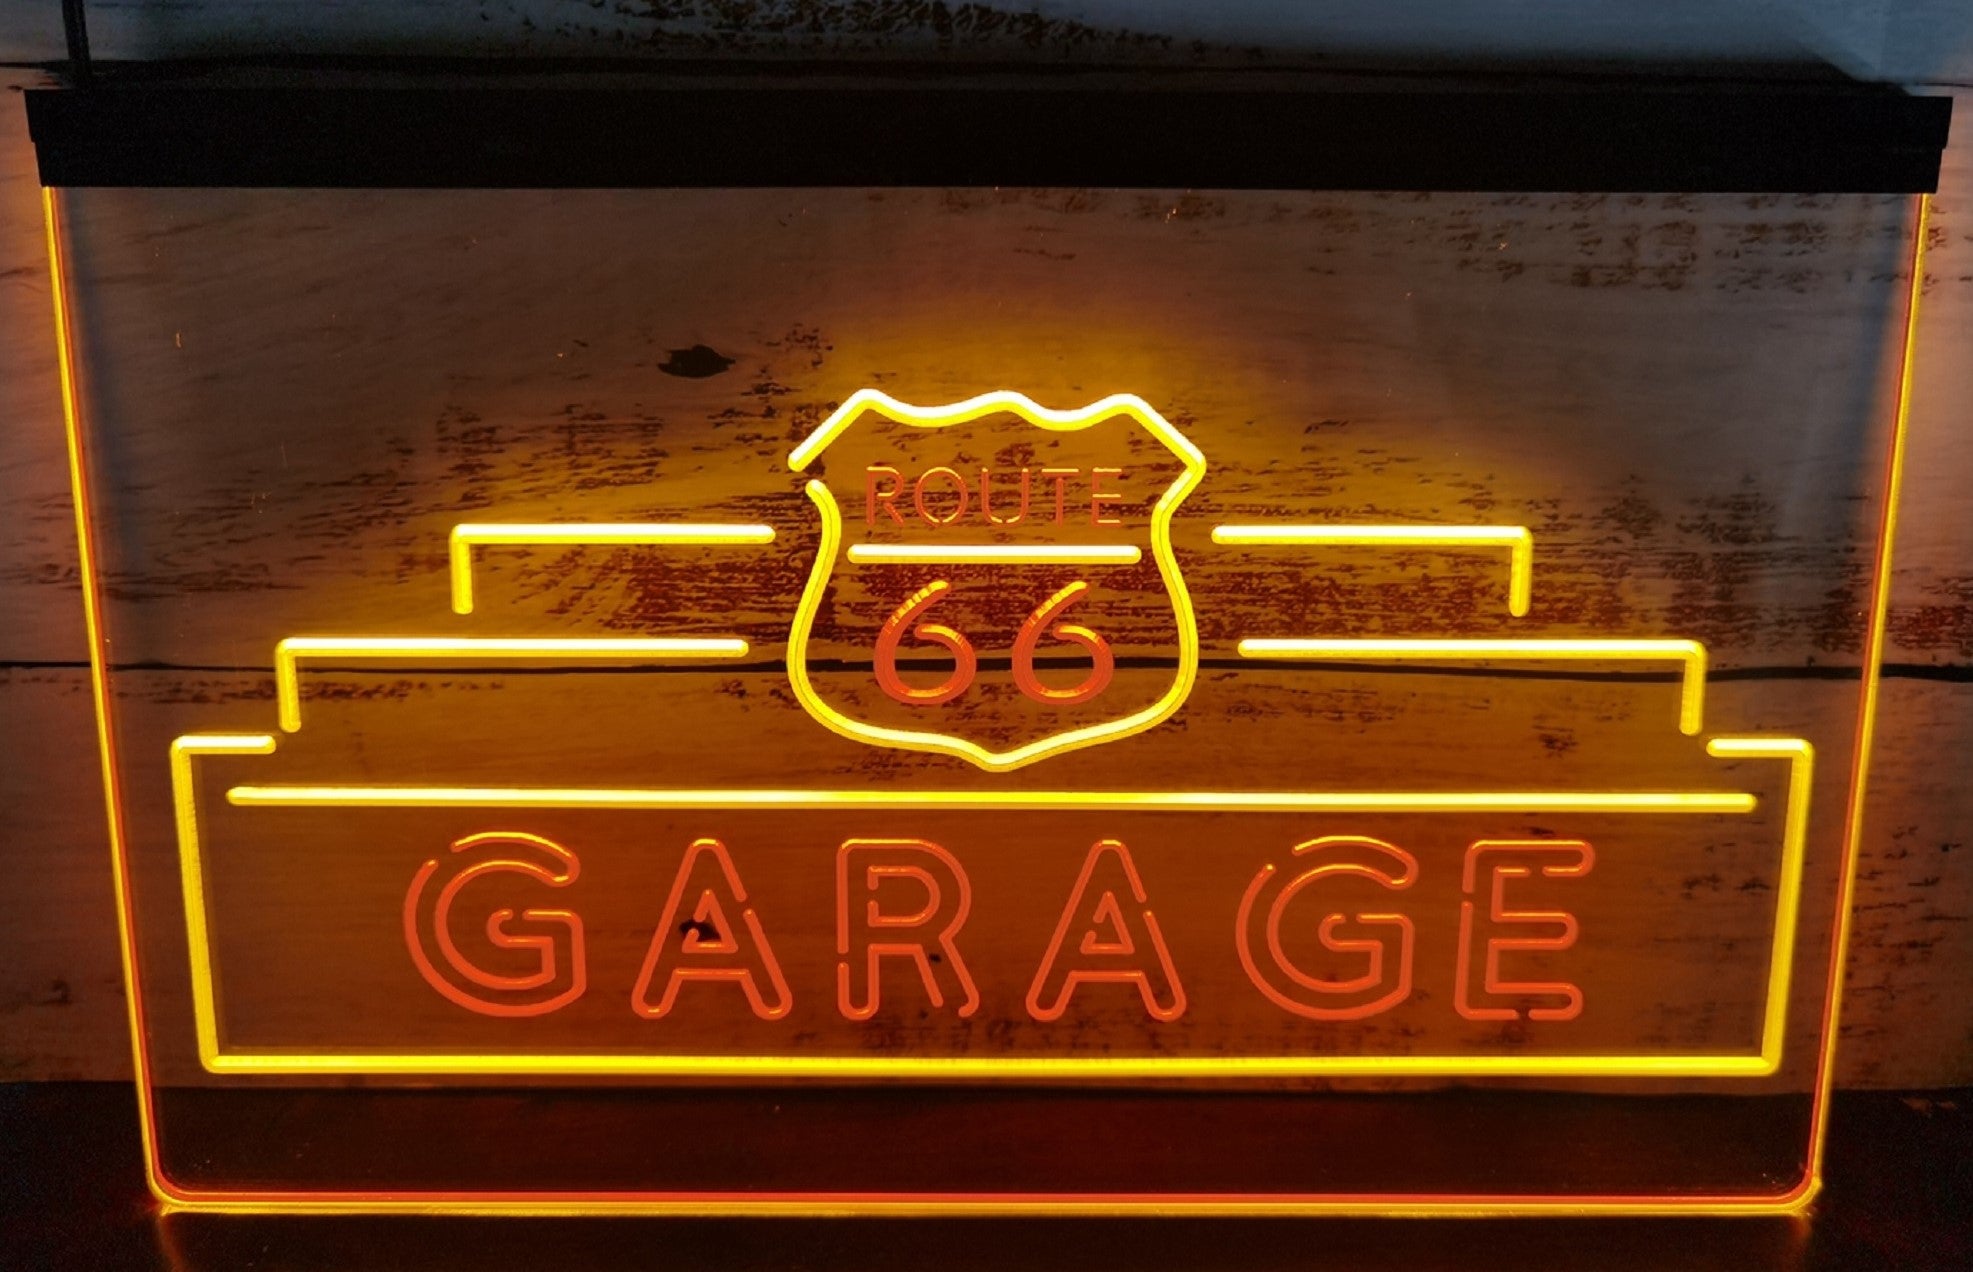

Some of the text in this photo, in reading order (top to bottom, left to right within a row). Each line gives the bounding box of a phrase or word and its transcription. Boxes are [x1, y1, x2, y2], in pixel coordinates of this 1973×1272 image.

[866, 466, 1122, 527] ROUTE
[873, 580, 1114, 705] 66
[403, 831, 1595, 1021] GARAGE
